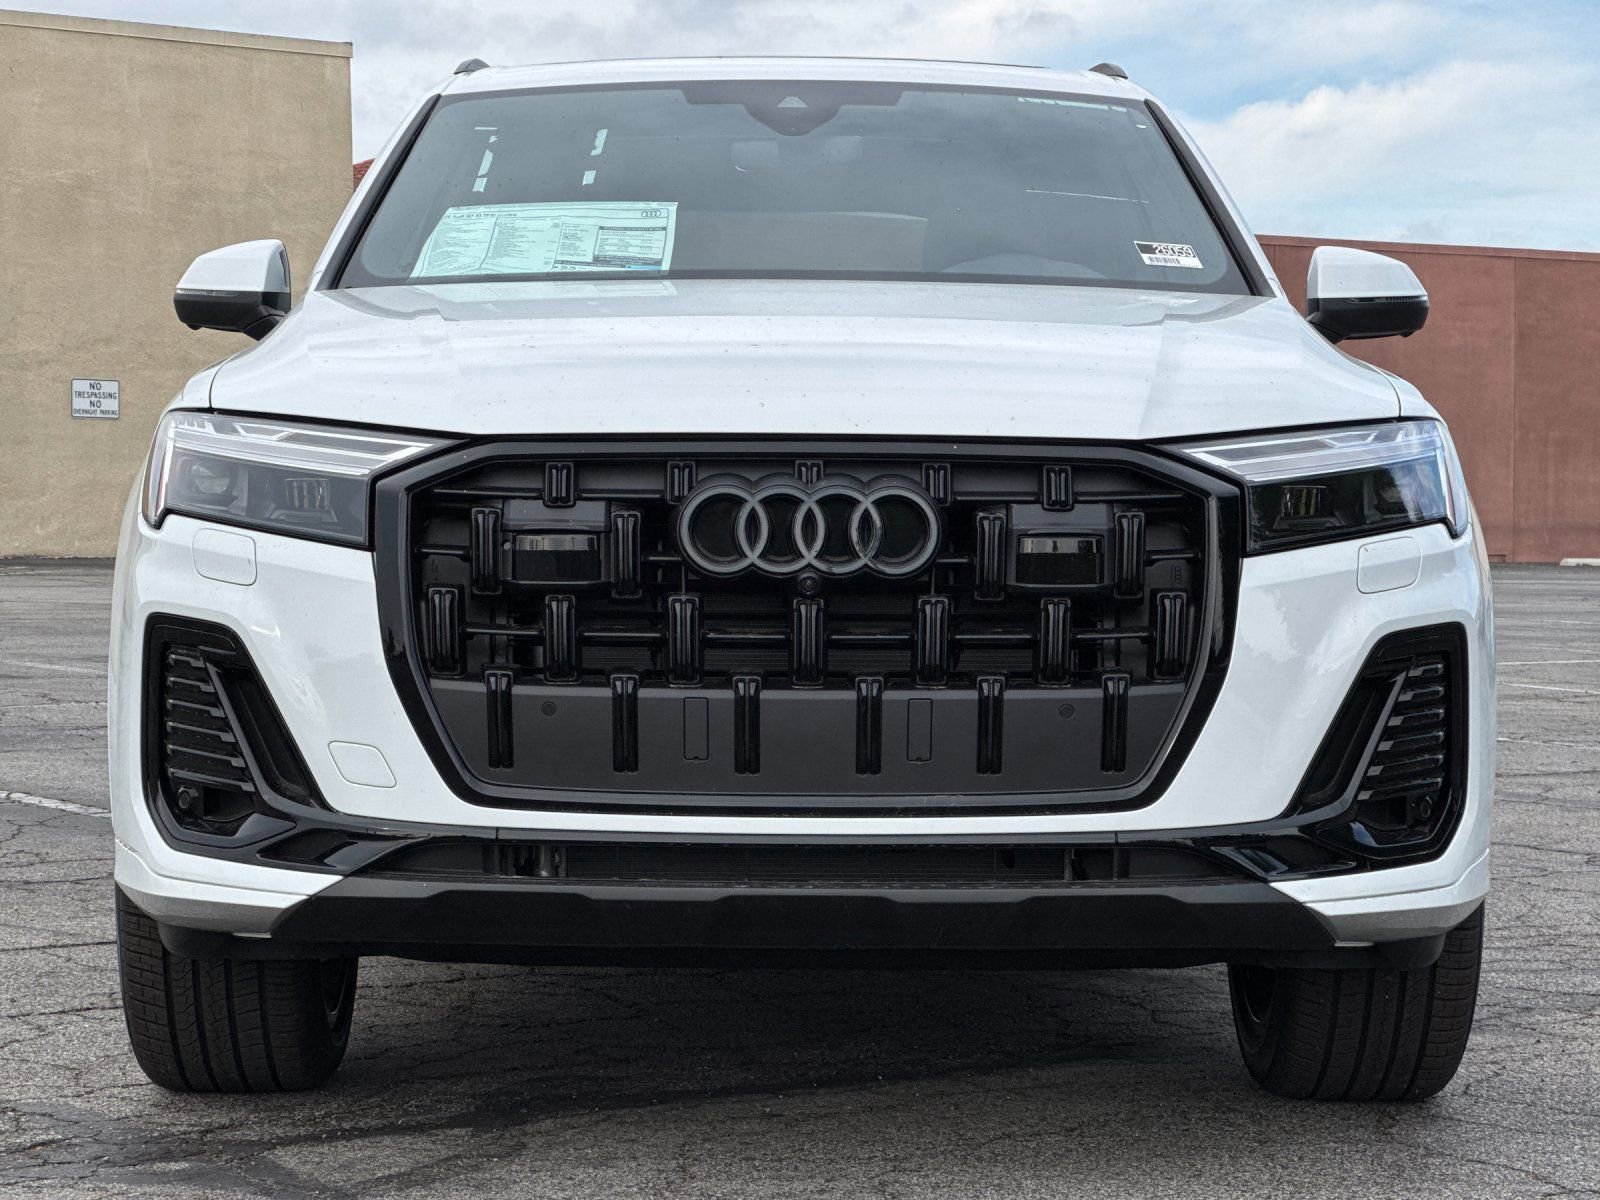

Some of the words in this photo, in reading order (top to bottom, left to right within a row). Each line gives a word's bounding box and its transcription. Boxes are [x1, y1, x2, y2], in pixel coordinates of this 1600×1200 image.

[1152, 244, 1194, 257] 26059
[89, 382, 102, 390] NO
[74, 390, 117, 400] TRESPASSING
[89, 400, 102, 408] NO
